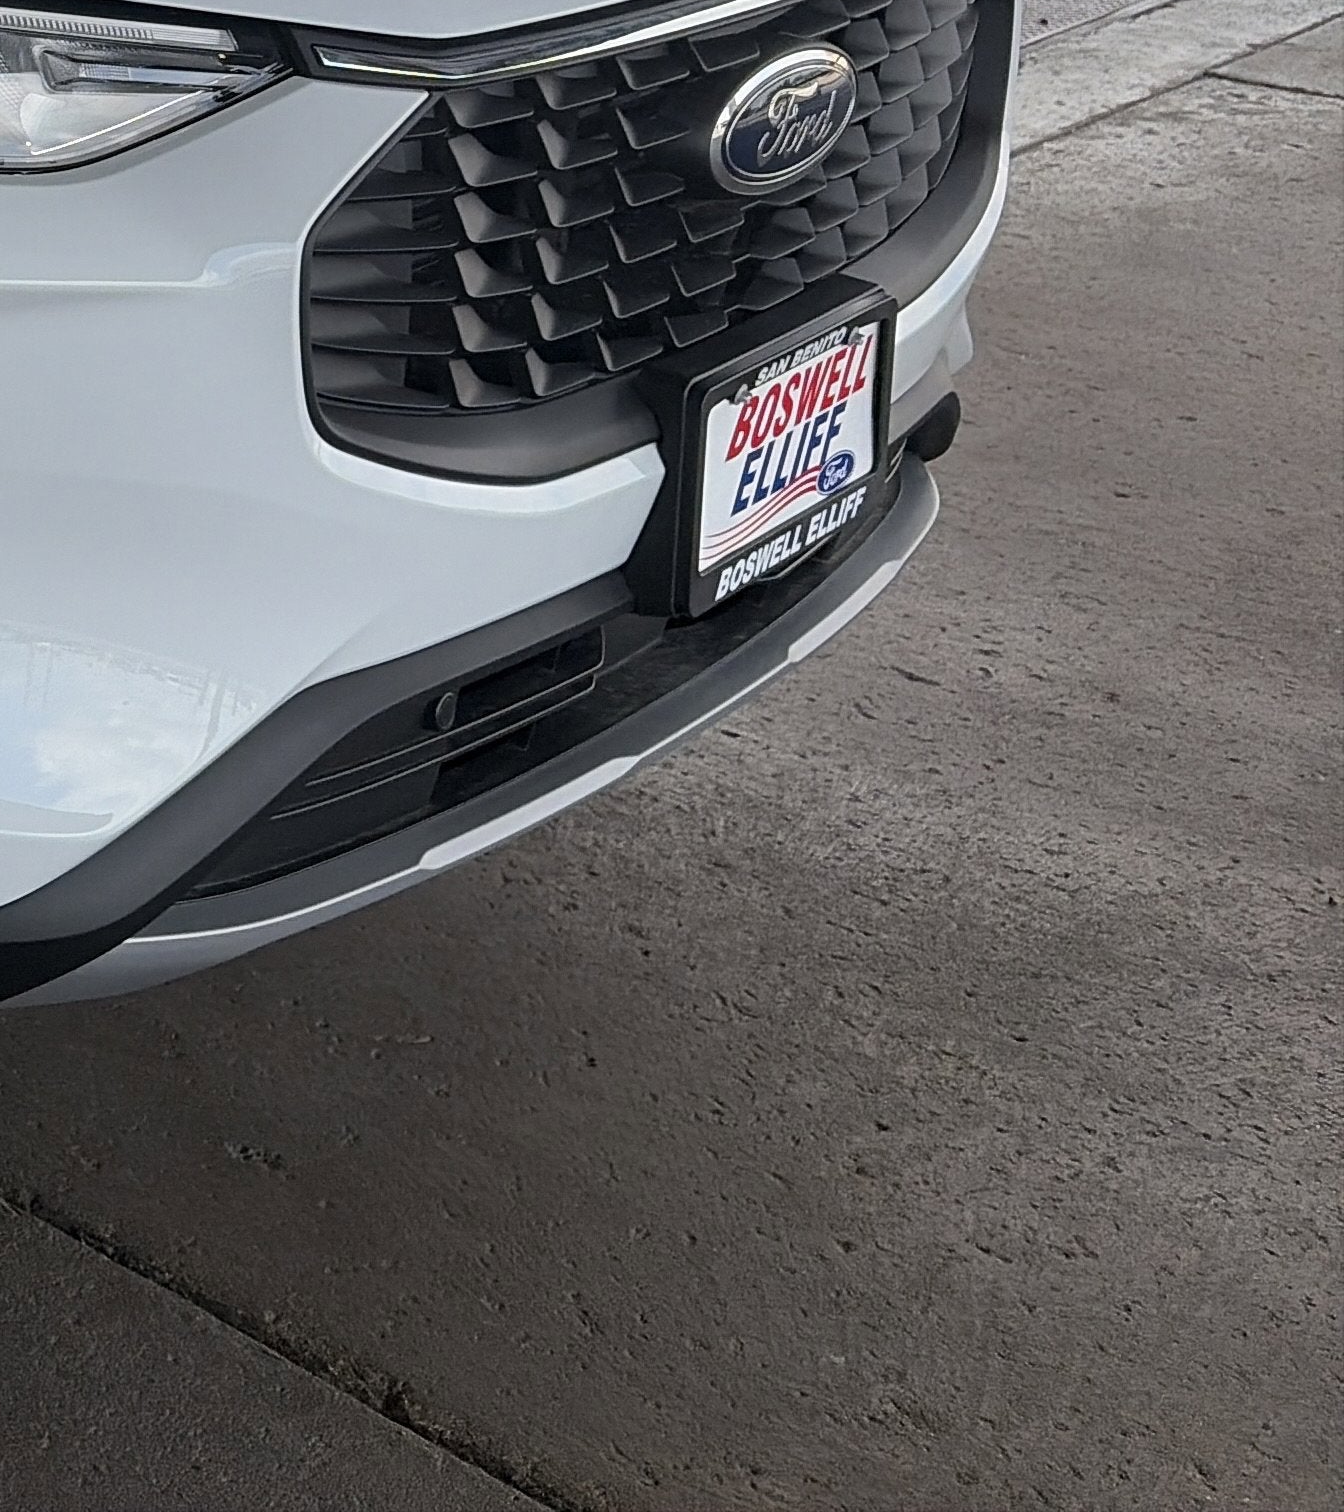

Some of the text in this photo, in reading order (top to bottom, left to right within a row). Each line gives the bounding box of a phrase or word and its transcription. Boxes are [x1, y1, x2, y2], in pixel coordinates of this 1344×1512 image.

[757, 81, 838, 168] Ford
[725, 334, 873, 463] BOSWELL
[755, 325, 848, 386] SAN BENITO
[730, 400, 847, 517] ELLIFF
[823, 456, 849, 489] Ford
[715, 486, 867, 602] BOSWELL ELLIFF
